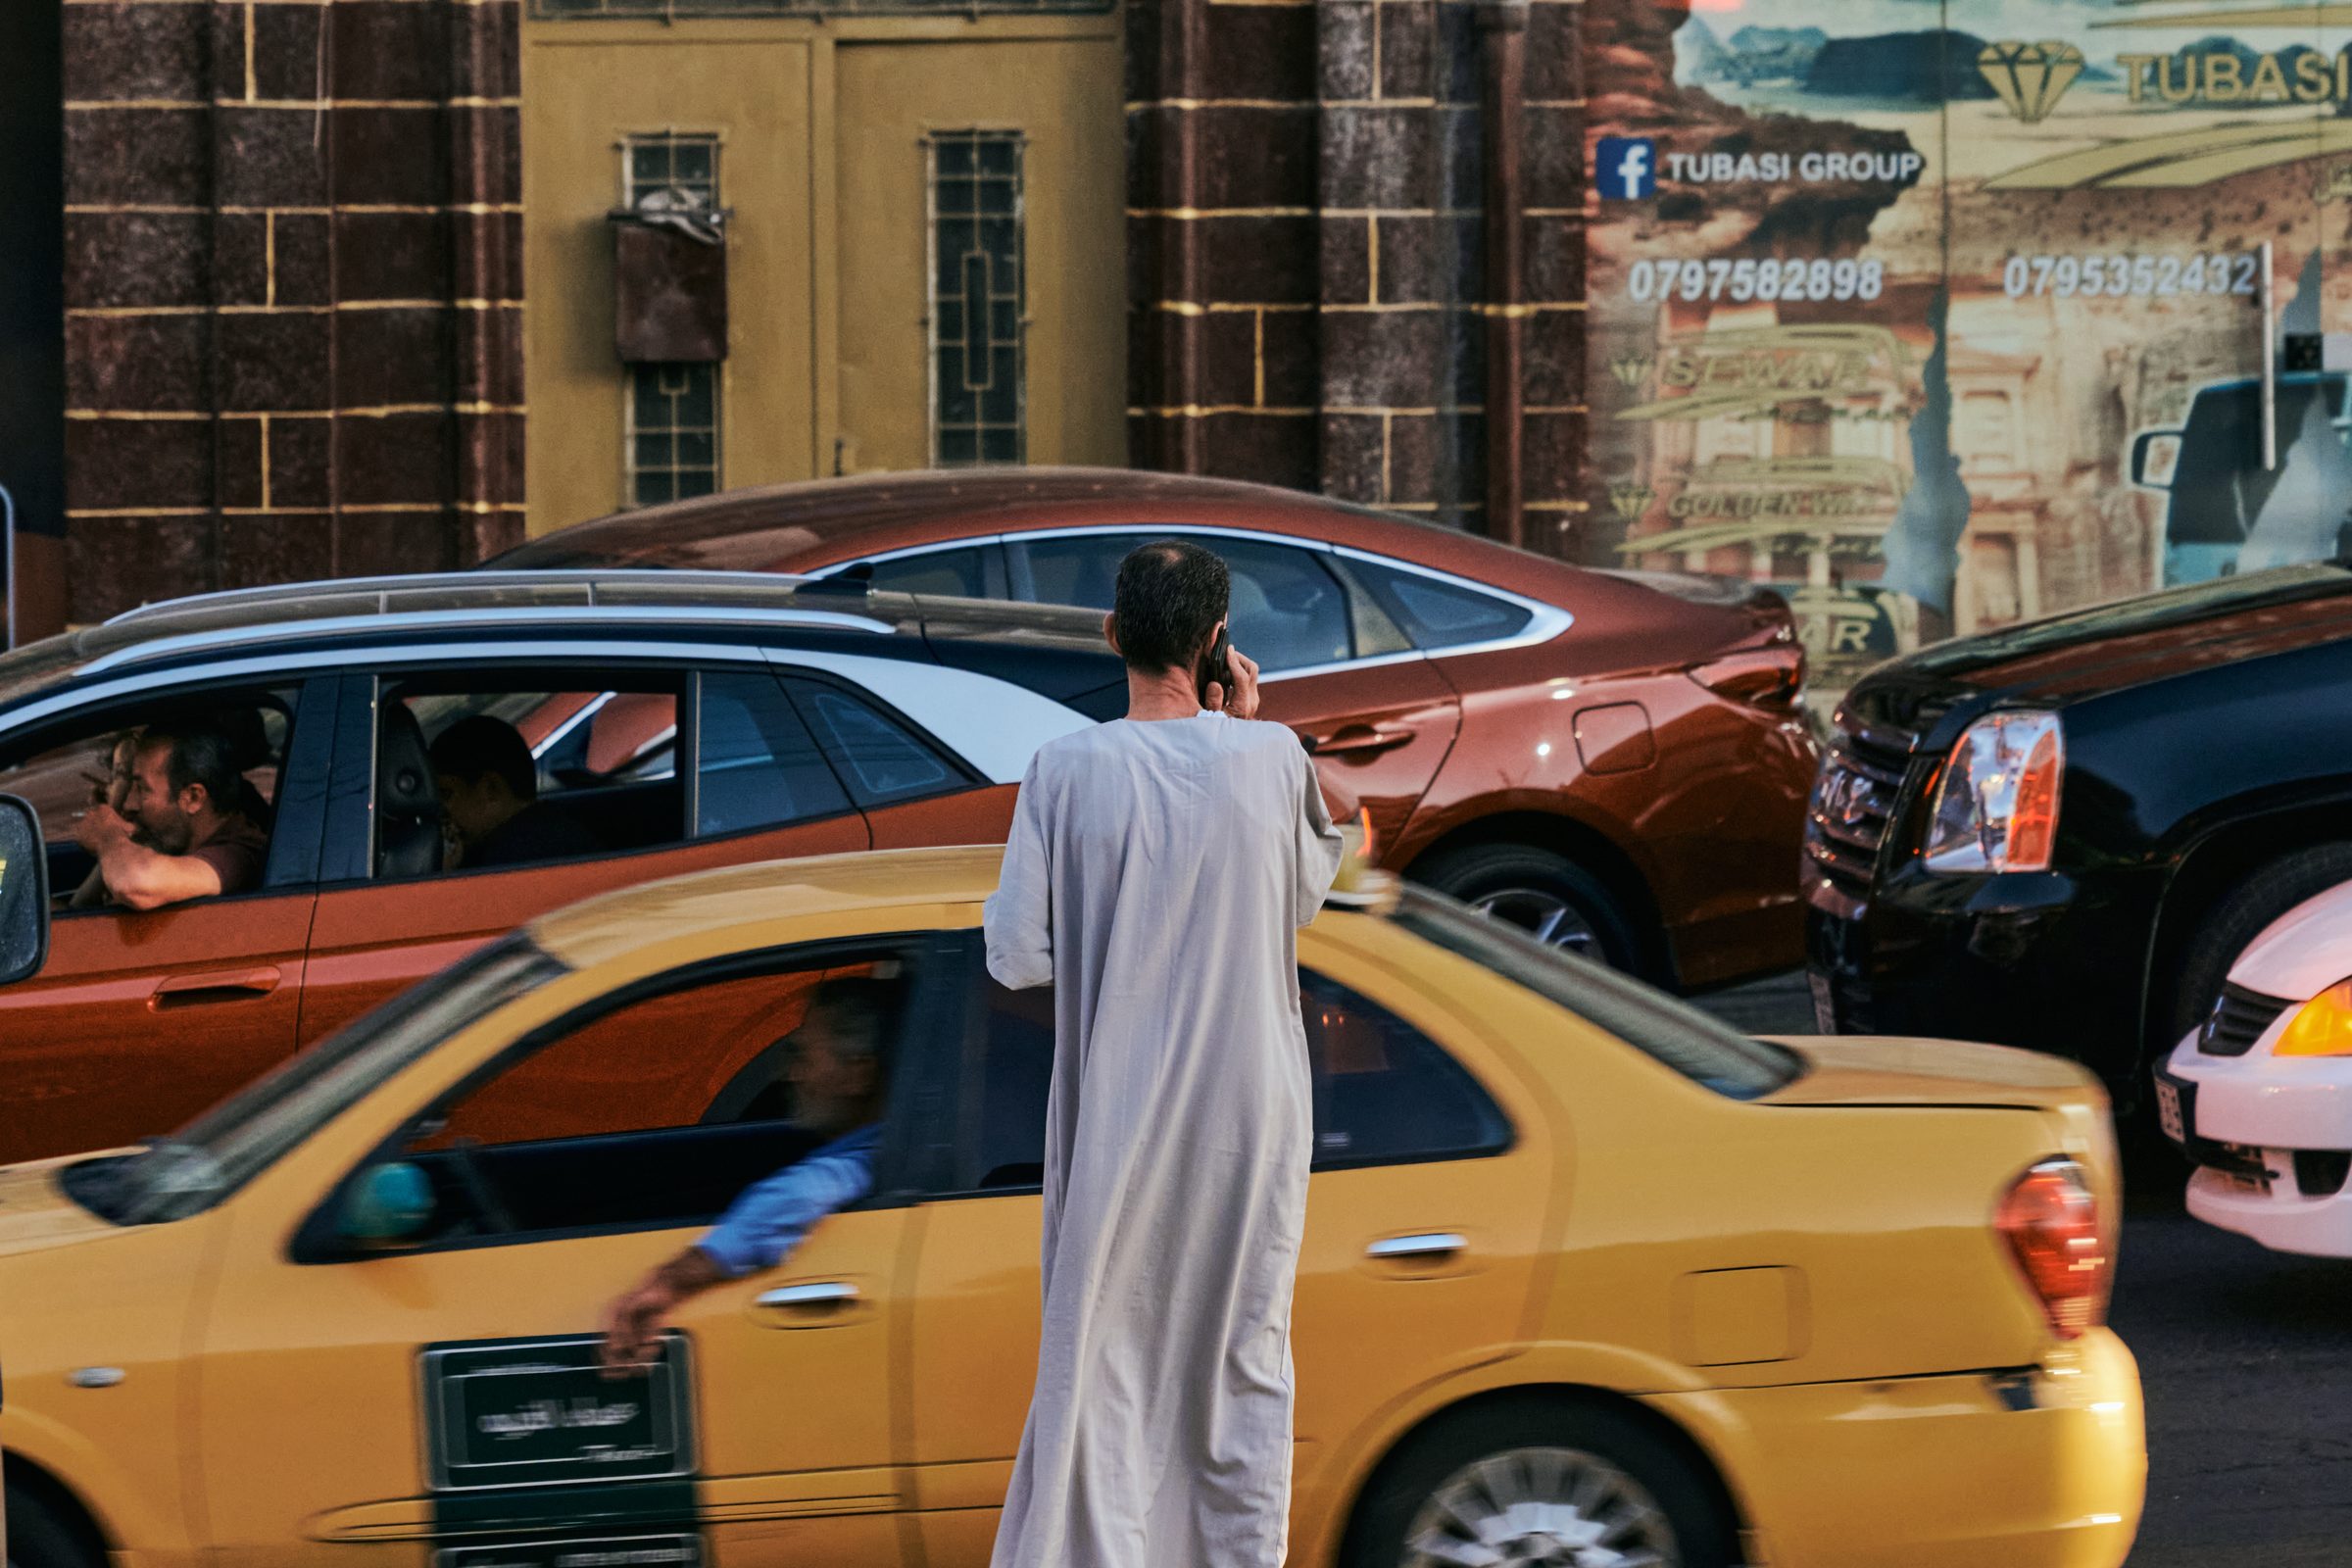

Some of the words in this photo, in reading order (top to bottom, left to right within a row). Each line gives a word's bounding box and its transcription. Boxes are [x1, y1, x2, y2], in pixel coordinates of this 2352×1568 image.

[2116, 52, 2350, 102] TUBASI
[1666, 152, 1791, 182] TUBASI
[1798, 152, 1922, 182] GROUP
[1628, 258, 1884, 302] 0797582898
[2003, 254, 2256, 298] 0795352432
